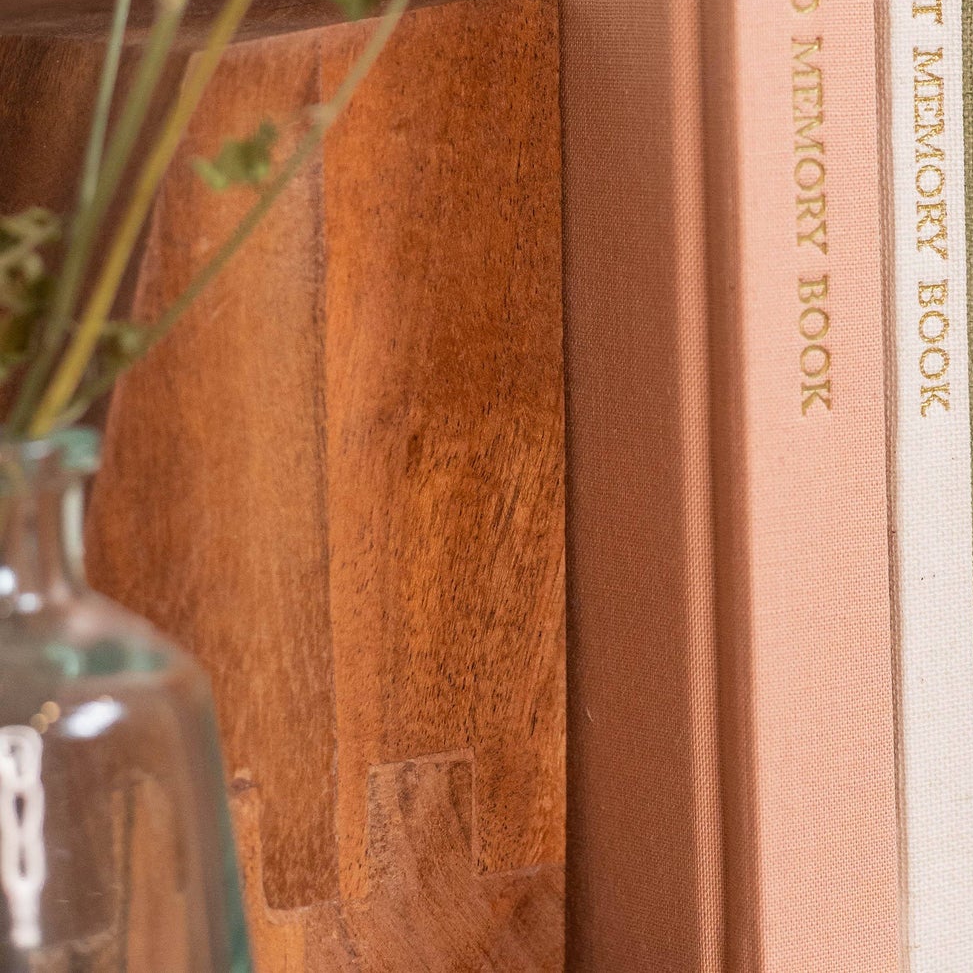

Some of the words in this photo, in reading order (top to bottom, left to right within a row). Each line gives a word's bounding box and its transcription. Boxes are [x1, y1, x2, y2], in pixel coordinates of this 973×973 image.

[791, 36, 829, 255] MEMORY
[913, 46, 949, 260] MEMORY
[798, 275, 832, 417] BOOK
[918, 279, 950, 418] BOOK
